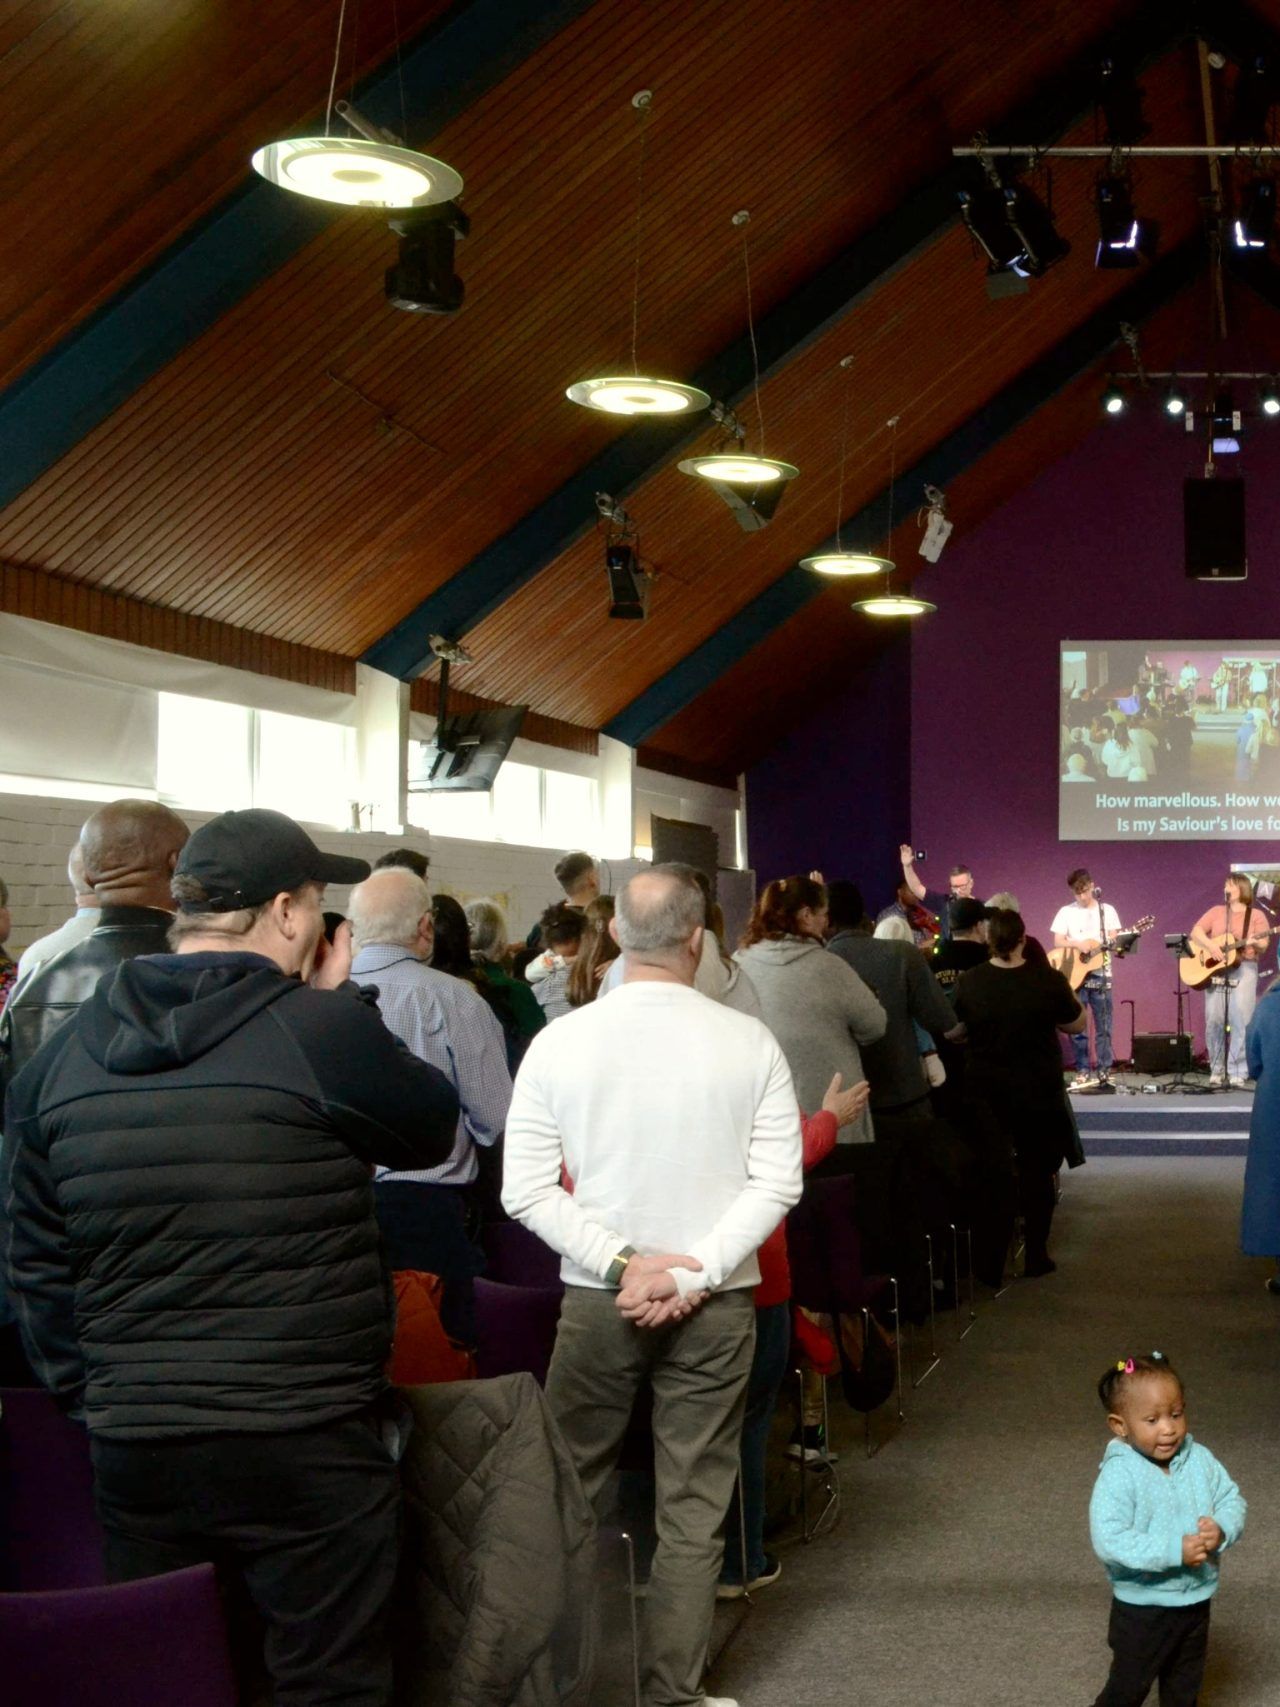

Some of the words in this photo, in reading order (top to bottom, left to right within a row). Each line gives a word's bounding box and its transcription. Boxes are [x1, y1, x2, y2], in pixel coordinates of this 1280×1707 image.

[1096, 793, 1131, 808] How
[1134, 792, 1221, 808] marvellous.
[1225, 792, 1262, 808] How
[1117, 817, 1129, 832] Is
[1133, 820, 1156, 836] my
[1160, 816, 1228, 832] Saviour's
[1232, 816, 1263, 832] love
